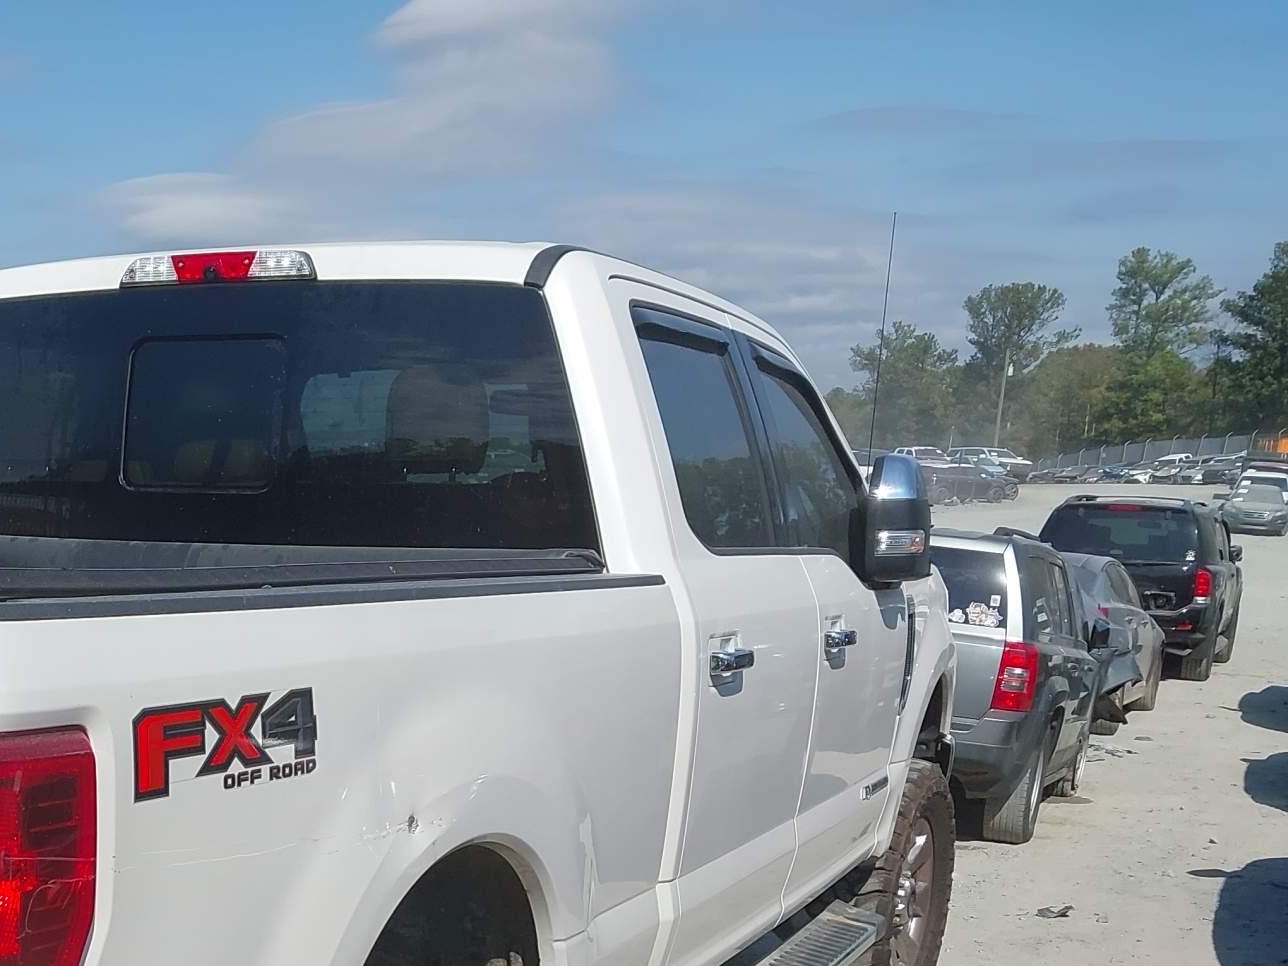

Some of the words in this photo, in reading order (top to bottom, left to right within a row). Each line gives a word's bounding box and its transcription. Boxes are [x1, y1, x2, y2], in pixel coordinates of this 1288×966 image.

[132, 686, 318, 804] FX4
[223, 769, 262, 790] OFF
[268, 759, 317, 781] ROAD
